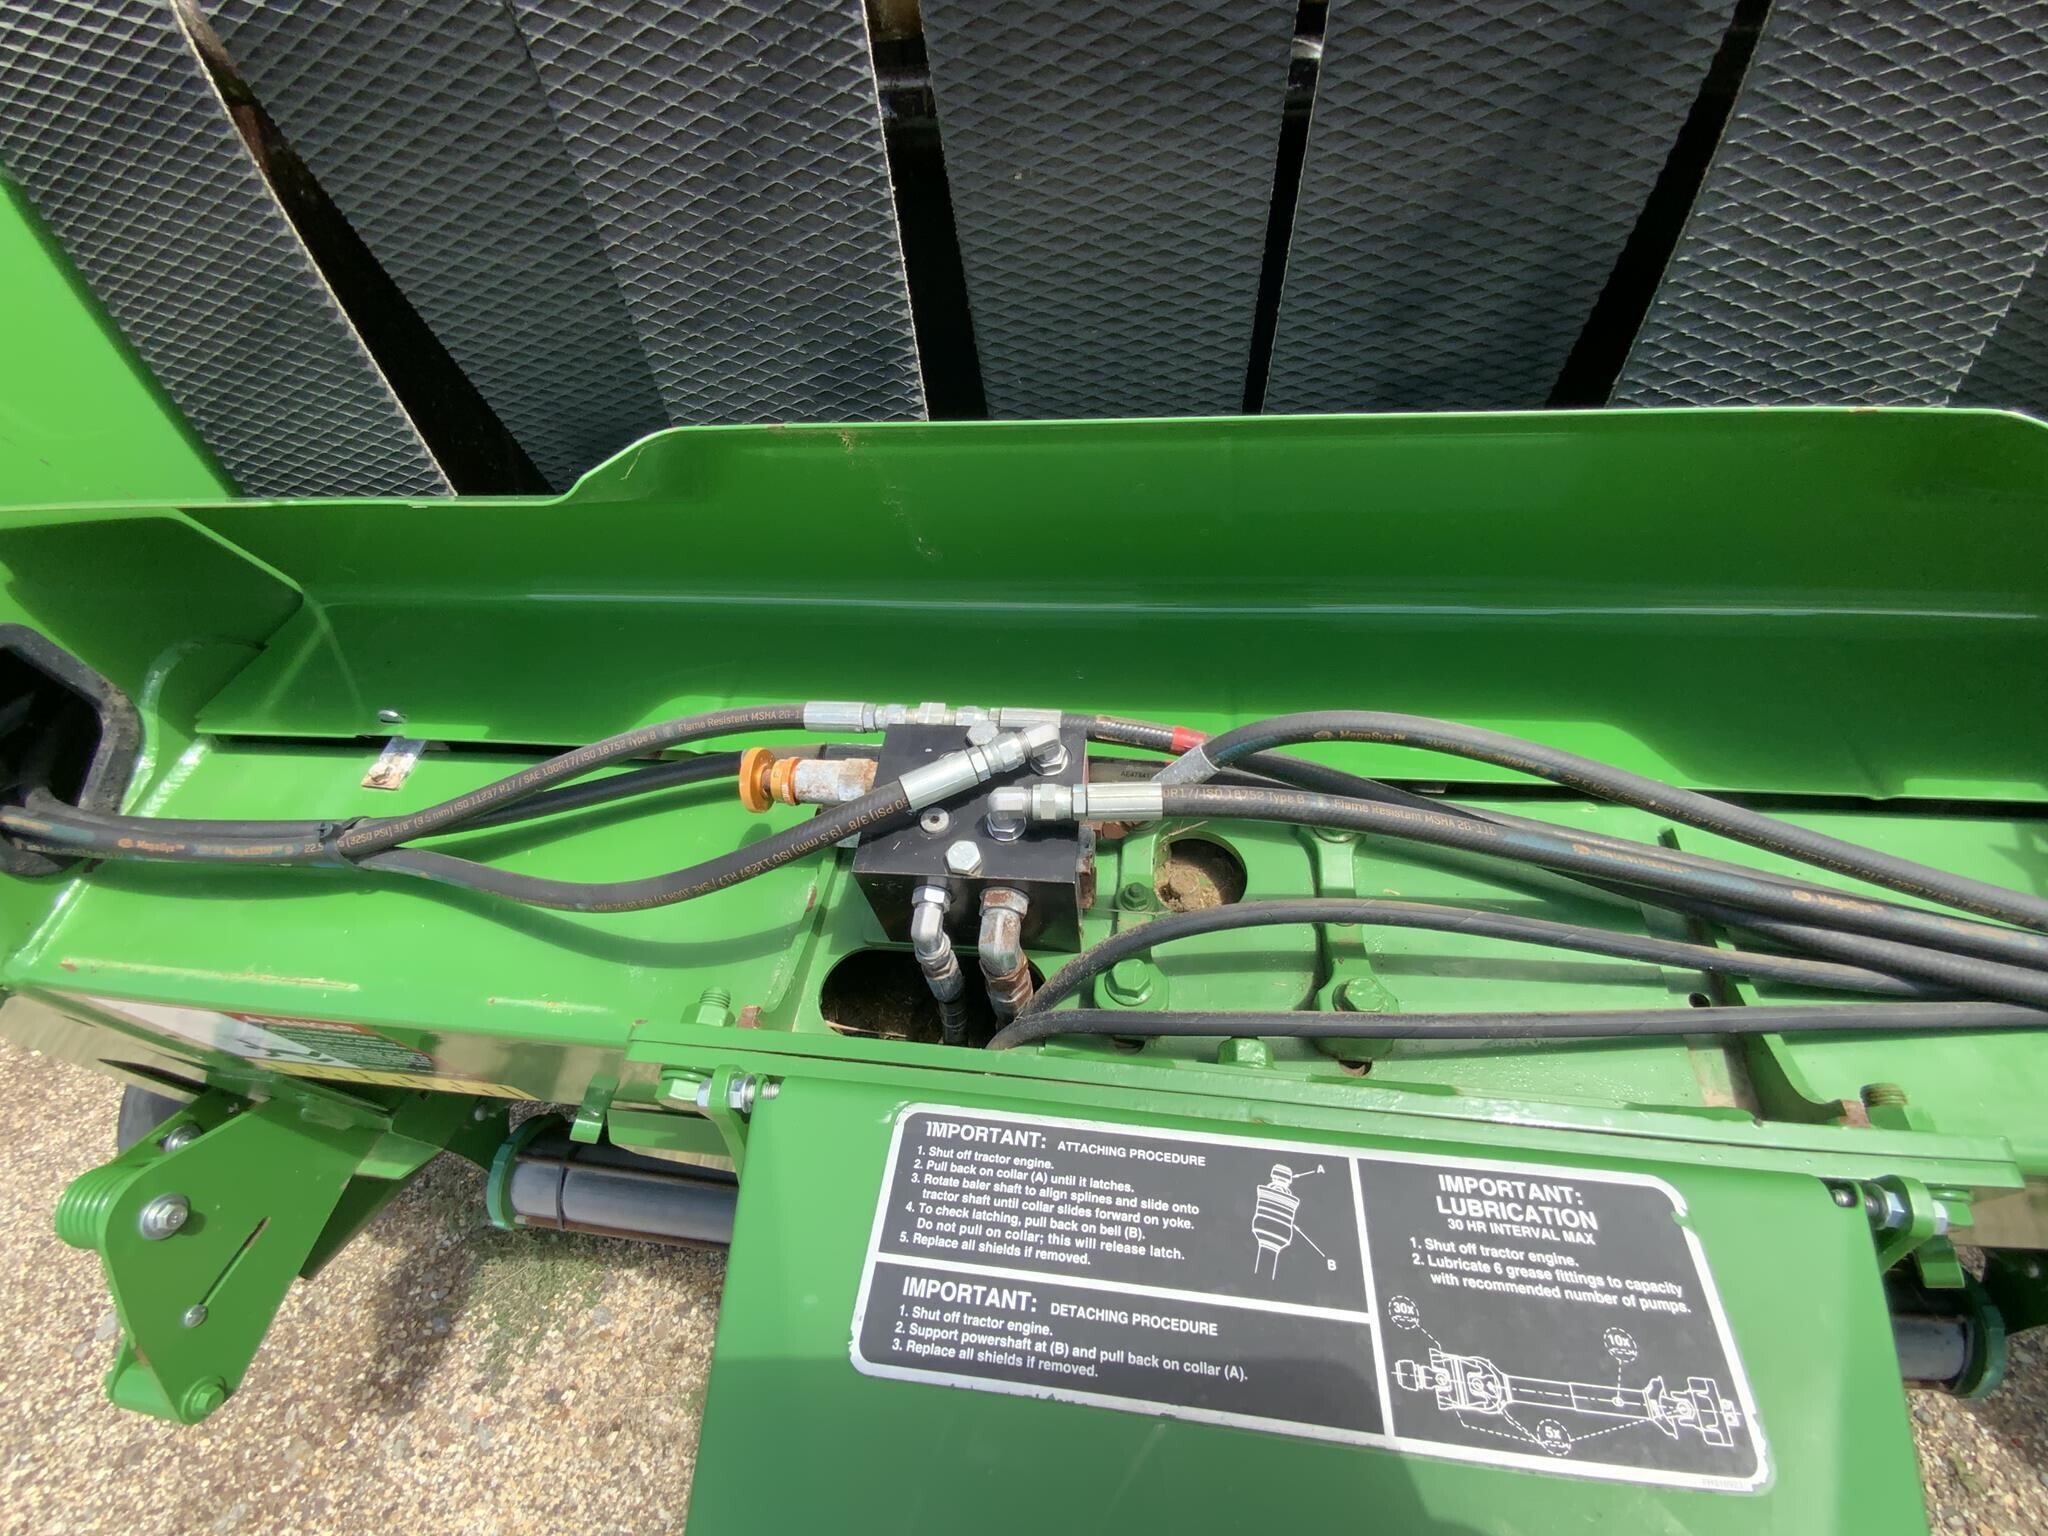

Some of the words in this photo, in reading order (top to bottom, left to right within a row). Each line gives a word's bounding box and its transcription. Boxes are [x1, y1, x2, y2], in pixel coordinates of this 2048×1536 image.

[524, 770, 542, 784] SAE
[599, 739, 626, 757] 18752
[918, 1145, 925, 1155] 1.
[929, 1146, 954, 1158] Shut
[956, 1150, 972, 1160] off
[974, 1152, 1011, 1164] tractor
[1013, 1157, 1054, 1169] engine.
[926, 1122, 1046, 1148] IMPORTANT:
[1058, 1141, 1126, 1157] ATTACHING
[1130, 1148, 1206, 1166] PROCEDURE
[913, 1159, 923, 1169] 2.
[926, 1160, 947, 1171] Pull
[950, 1162, 976, 1174] back
[979, 1168, 993, 1176] on
[997, 1169, 1028, 1180] collar
[1031, 1171, 1048, 1184] (A)
[1051, 1175, 1076, 1185] until
[1079, 1176, 1087, 1187] it
[1090, 1178, 1134, 1192] latches.
[1317, 1165, 1325, 1174] A
[911, 1172, 920, 1183] 3.
[924, 1174, 959, 1187] Rotate
[962, 1178, 991, 1190] baler
[994, 1182, 1022, 1194] shaft
[1025, 1185, 1036, 1196] to
[1039, 1187, 1067, 1201] align
[1071, 1192, 1112, 1204] splines
[1116, 1197, 1138, 1207] and
[1140, 1198, 1169, 1211] slide
[1172, 1204, 1199, 1214] onto
[1438, 1174, 1583, 1205] IMPORTANT:
[905, 1201, 914, 1212] 4.
[919, 1202, 933, 1214] To
[936, 1205, 969, 1218] check
[972, 1208, 1021, 1227] latching,
[1024, 1216, 1046, 1228] pull
[1050, 1218, 1078, 1231] back
[1081, 1224, 1096, 1233] on
[1100, 1223, 1121, 1236] bell
[1125, 1226, 1145, 1241] (B).
[922, 1188, 960, 1202] tractor
[962, 1193, 990, 1205] shaft
[994, 1198, 1019, 1208] until
[1022, 1200, 1054, 1212] collar
[1058, 1204, 1092, 1217] slides
[1095, 1208, 1140, 1223] forward
[1144, 1216, 1159, 1225] on
[1162, 1217, 1194, 1229] yoke.
[1436, 1196, 1598, 1230] LUBRICATION
[900, 1231, 908, 1242] 5.
[913, 1232, 958, 1248] Replace
[961, 1239, 975, 1250] all
[978, 1241, 1021, 1256] shields
[1024, 1246, 1033, 1258] if
[1035, 1250, 1090, 1265] removed.
[917, 1217, 933, 1230] Do
[936, 1222, 956, 1232] not
[959, 1224, 982, 1236] pull
[986, 1228, 1001, 1238] on
[1005, 1230, 1043, 1245] collar;
[1048, 1233, 1071, 1246] this
[1075, 1237, 1096, 1249] will
[1100, 1241, 1146, 1255] release
[1150, 1245, 1184, 1260] latch.
[1448, 1218, 1464, 1230] 30
[1467, 1220, 1487, 1232] HR
[1490, 1223, 1560, 1241] INTERVAL
[1562, 1231, 1596, 1245] MAX
[1327, 1259, 1337, 1271] B
[1410, 1237, 1422, 1249] 1.
[1424, 1238, 1456, 1252] Shut
[1459, 1243, 1477, 1254] off
[1480, 1245, 1524, 1260] tractor
[1528, 1252, 1579, 1267] engine.
[1412, 1252, 1424, 1265] 2.
[1428, 1254, 1490, 1273] Lubricate
[1494, 1262, 1502, 1274] 6
[1506, 1266, 1552, 1280] grease
[1555, 1270, 1604, 1288] fittings
[1607, 1276, 1622, 1288] to
[1625, 1280, 1682, 1298] capacity
[902, 1276, 1036, 1312] IMPORTANT:
[1050, 1302, 1128, 1324] DETACHING
[1132, 1313, 1218, 1336] PROCEDURE
[1393, 1302, 1414, 1316] 30x
[1430, 1272, 1459, 1286] with
[1462, 1278, 1561, 1298] recommended
[1564, 1290, 1618, 1304] number
[1622, 1294, 1636, 1307] of
[1639, 1298, 1691, 1314] pumps.
[900, 1304, 908, 1316] 1.
[912, 1306, 940, 1321] Shut
[943, 1311, 960, 1323] off
[963, 1313, 1004, 1328] tractor
[1007, 1321, 1052, 1336] engine.
[892, 1338, 902, 1351] 3.
[906, 1340, 956, 1358] Replace
[959, 1348, 974, 1360] all
[977, 1350, 1022, 1366] shields
[1027, 1356, 1035, 1368] if
[1038, 1360, 1098, 1377] removed.
[894, 1321, 905, 1334] 2.
[909, 1323, 958, 1340] Support
[961, 1332, 1032, 1350] powershaft
[1034, 1341, 1047, 1352] at
[1050, 1341, 1069, 1358] (B)
[1072, 1347, 1096, 1359] and
[1100, 1350, 1124, 1363] pull
[1128, 1352, 1159, 1368] back
[1163, 1360, 1179, 1370] on
[1183, 1362, 1221, 1376] collar
[1224, 1365, 1248, 1382] (A).
[1607, 1334, 1631, 1348] 10x
[1545, 1426, 1561, 1439] 5x
